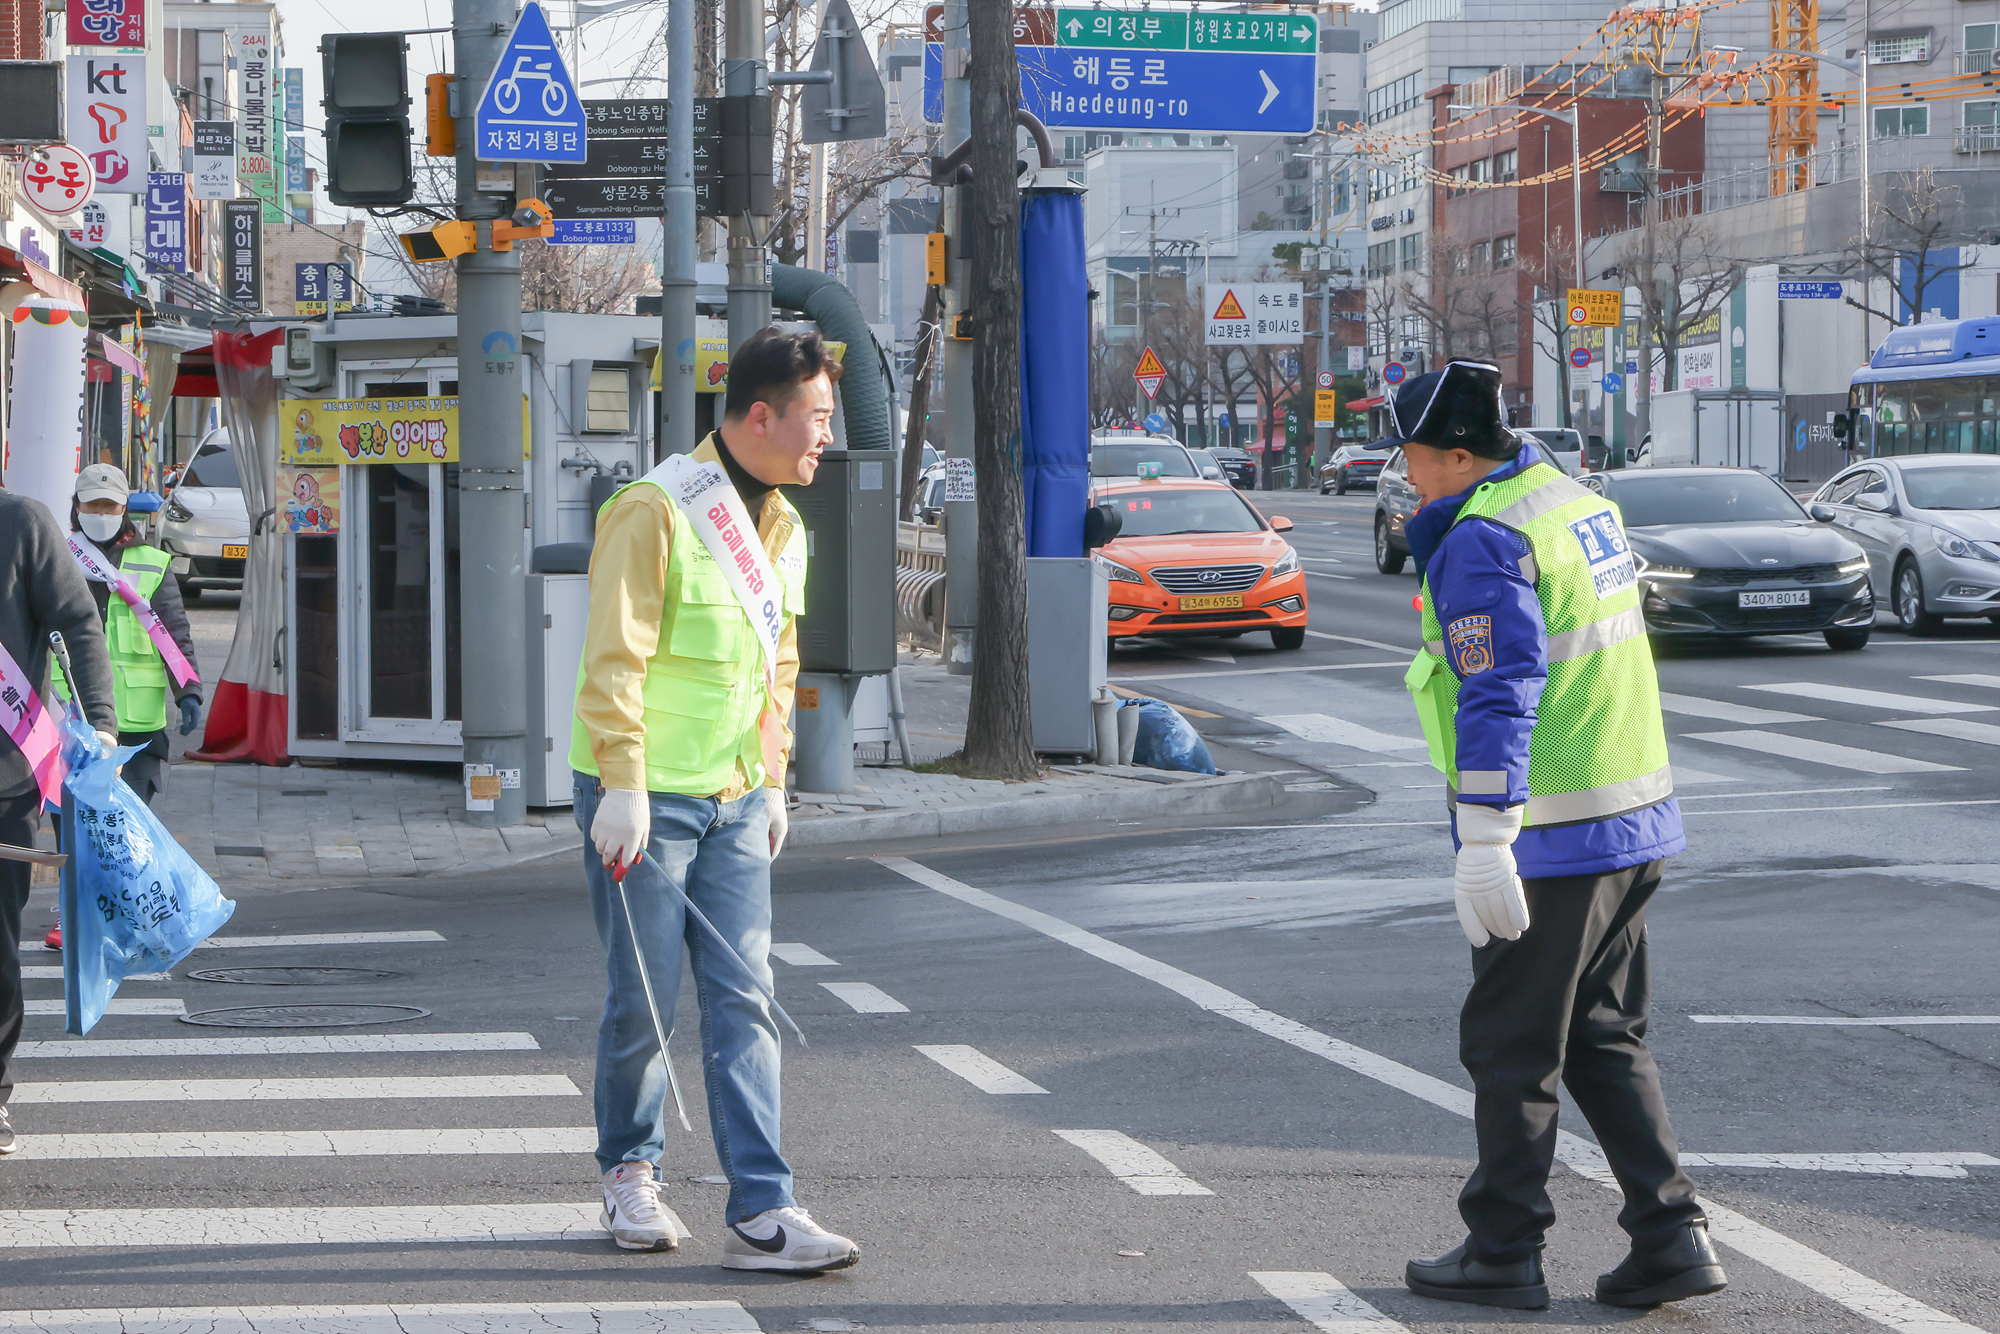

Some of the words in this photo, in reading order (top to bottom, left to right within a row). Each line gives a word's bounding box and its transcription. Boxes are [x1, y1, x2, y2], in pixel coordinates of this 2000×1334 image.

[128, 14, 142, 41] 지하
[1092, 16, 1162, 41] 의정부
[1195, 20, 1288, 43] 창원초교오거리
[242, 35, 266, 46] 24시
[87, 60, 127, 94] kt
[1073, 57, 1168, 90] 해등로
[243, 62, 267, 152] 콩나물국밥
[1051, 91, 1188, 119] Haedeung-ro
[585, 105, 708, 122] 도봉노인종합관
[587, 126, 618, 136] Dobong
[620, 125, 645, 134] Senior
[647, 124, 668, 134] Welfa
[196, 135, 233, 145] 세르지오
[487, 130, 578, 152] 자전거횡단
[241, 157, 270, 175] 3,800원
[607, 164, 652, 174] Dobong-gu
[654, 164, 667, 172] Hea
[27, 162, 85, 199] 우동
[602, 185, 651, 201] 쌍문2동
[576, 205, 632, 214] Ssangmun2-dong
[149, 188, 182, 249] 노래
[573, 222, 634, 233] 도봉로133길
[562, 235, 605, 244] Dobong-ro
[607, 235, 634, 244] 133-gil
[148, 251, 183, 263] 연습장
[234, 214, 253, 299] 하이클래스
[1780, 283, 1823, 292] 도봉로134길
[1258, 293, 1300, 308] 속도를
[1570, 292, 1619, 305] 어린이보호구역
[1573, 310, 1584, 319] 30
[1209, 324, 1251, 338] 사고잦은곳
[1257, 319, 1301, 333] 줄이시오
[485, 361, 515, 374] 도봉구
[679, 364, 695, 375] 도봉
[1321, 375, 1332, 384] 50
[322, 402, 353, 411] MBC,KBS
[355, 401, 365, 410] TV
[444, 399, 459, 410] 잉어
[390, 419, 448, 459] 잉어빵
[1576, 514, 1625, 561] 교통
[707, 501, 765, 596] 일일동장
[1212, 596, 1239, 607] 6955
[1776, 593, 1806, 605] 8014
